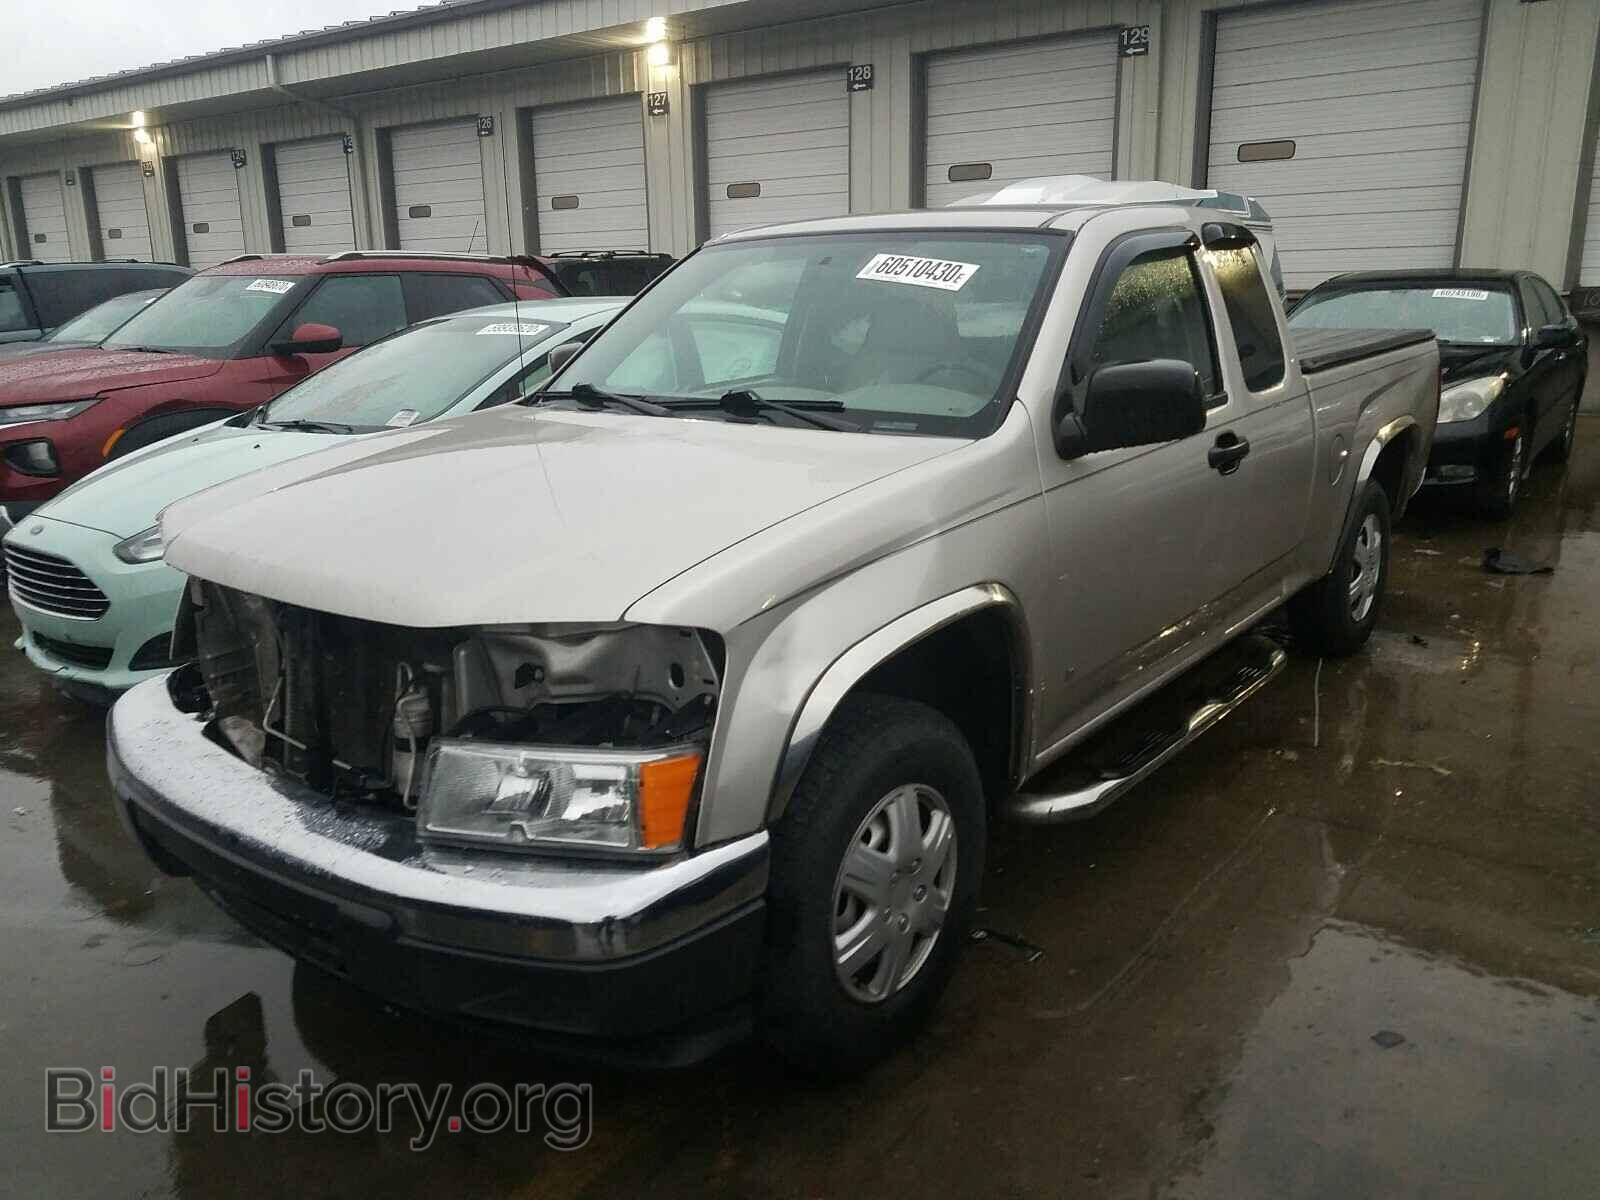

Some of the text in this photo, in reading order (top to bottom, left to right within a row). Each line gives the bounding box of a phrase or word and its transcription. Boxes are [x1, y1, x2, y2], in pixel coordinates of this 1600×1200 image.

[1121, 28, 1151, 46] 129
[848, 66, 871, 80] 128
[649, 93, 666, 106] 127
